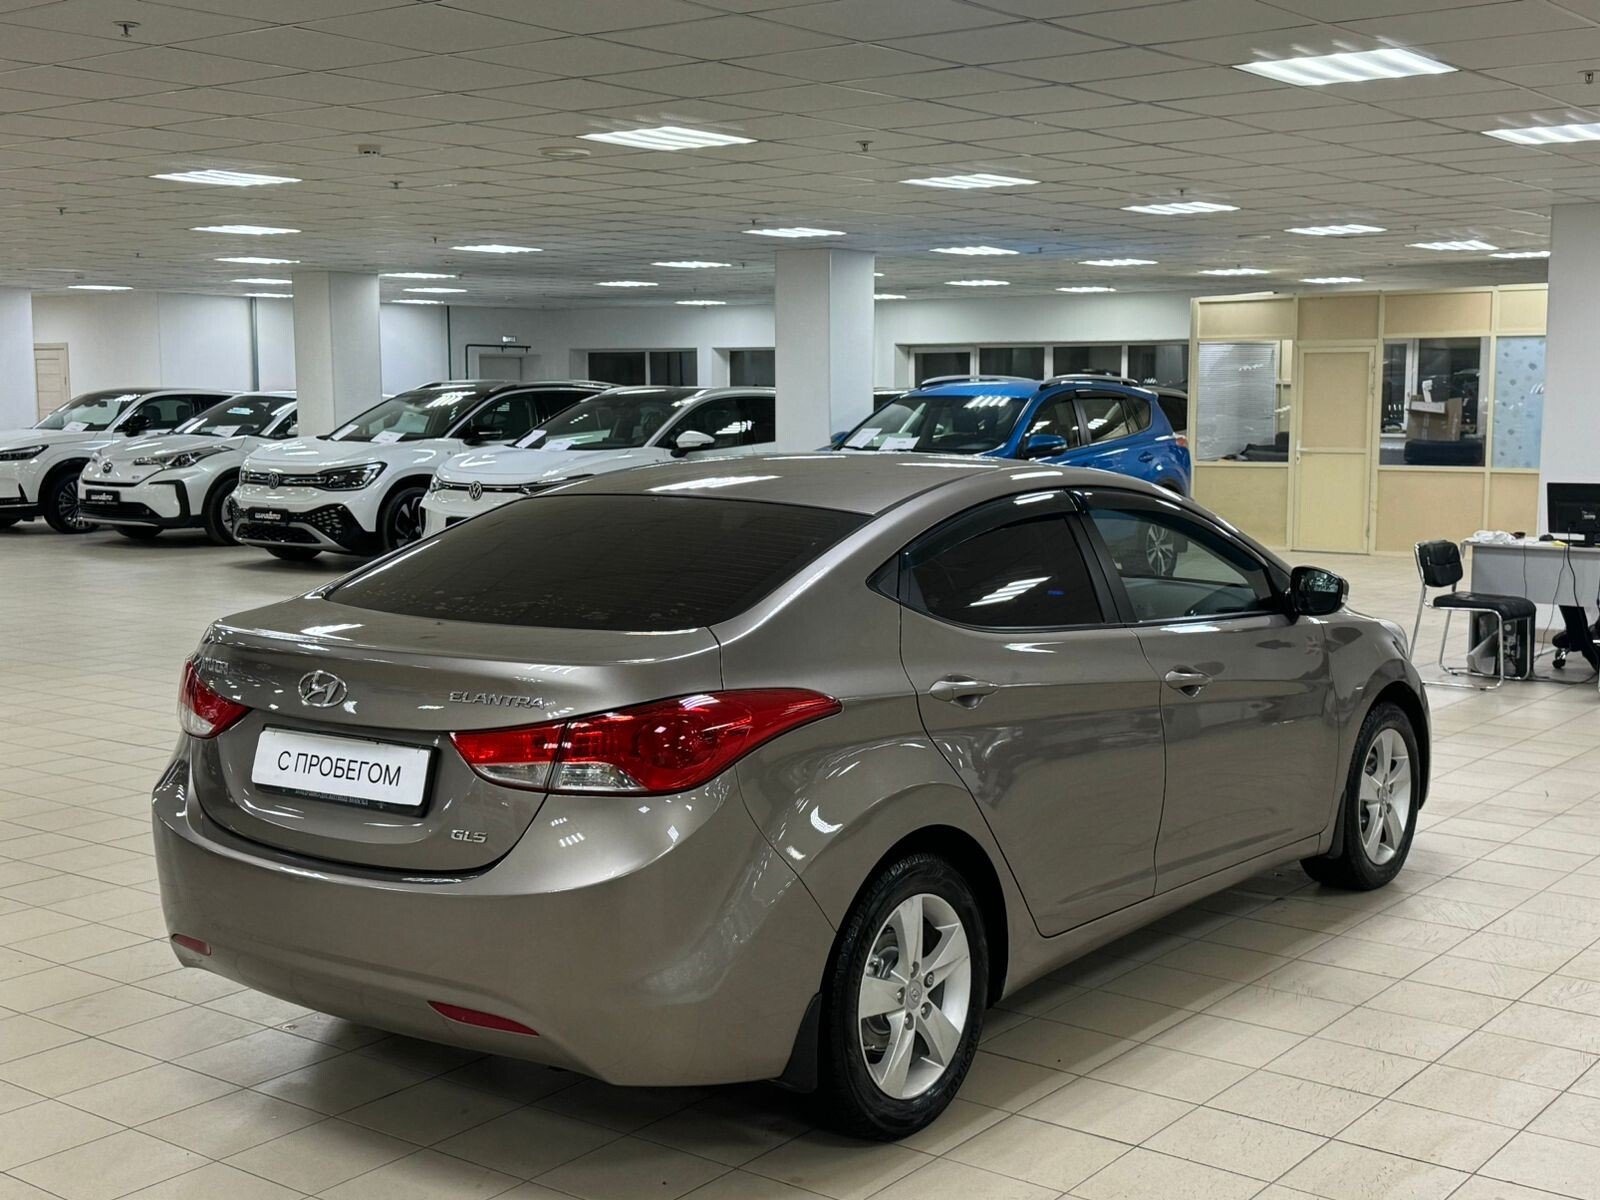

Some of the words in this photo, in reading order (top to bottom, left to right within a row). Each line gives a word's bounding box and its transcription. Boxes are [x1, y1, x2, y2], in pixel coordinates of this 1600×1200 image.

[449, 691, 545, 710] ELANTRA
[277, 750, 292, 771] С
[294, 752, 402, 787] ПРОБЕГОМ
[450, 829, 487, 844] GLS
